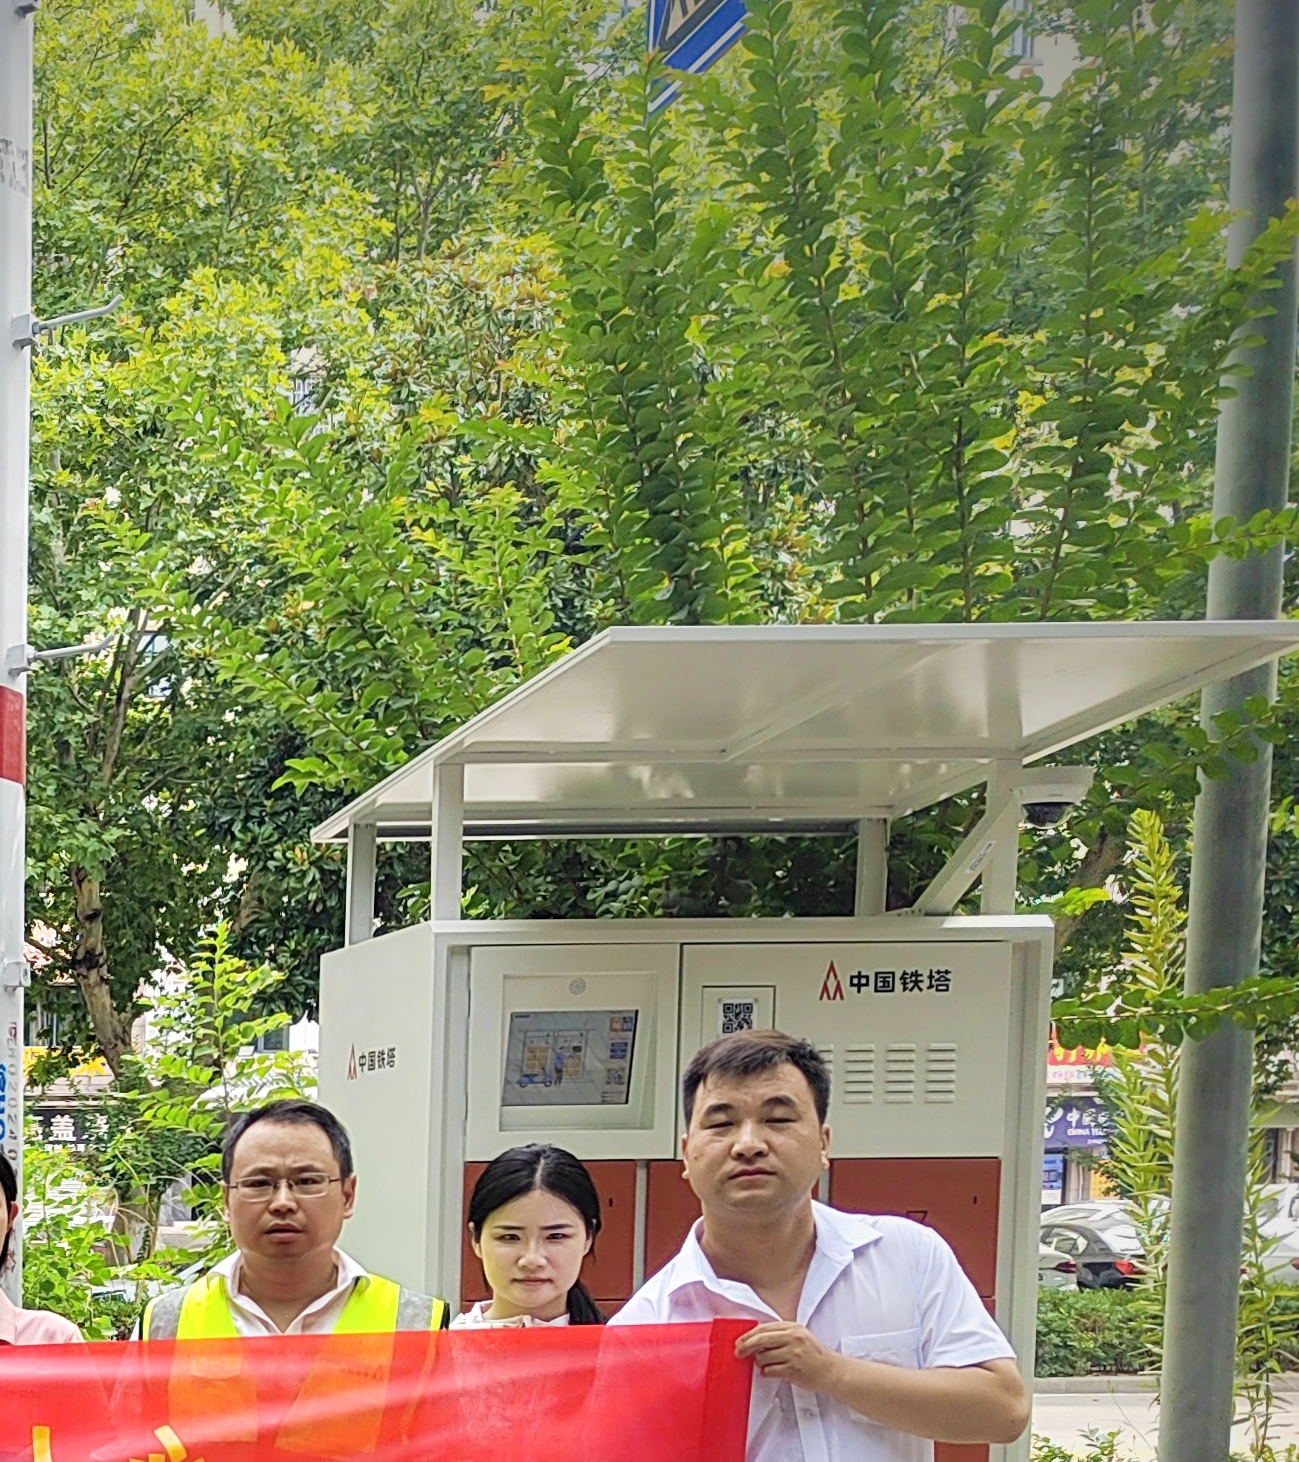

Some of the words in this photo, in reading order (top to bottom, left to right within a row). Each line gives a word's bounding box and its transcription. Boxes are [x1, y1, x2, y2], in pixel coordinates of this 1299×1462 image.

[849, 969, 952, 994] 中国铁塔
[358, 1047, 396, 1073] 中国铁塔
